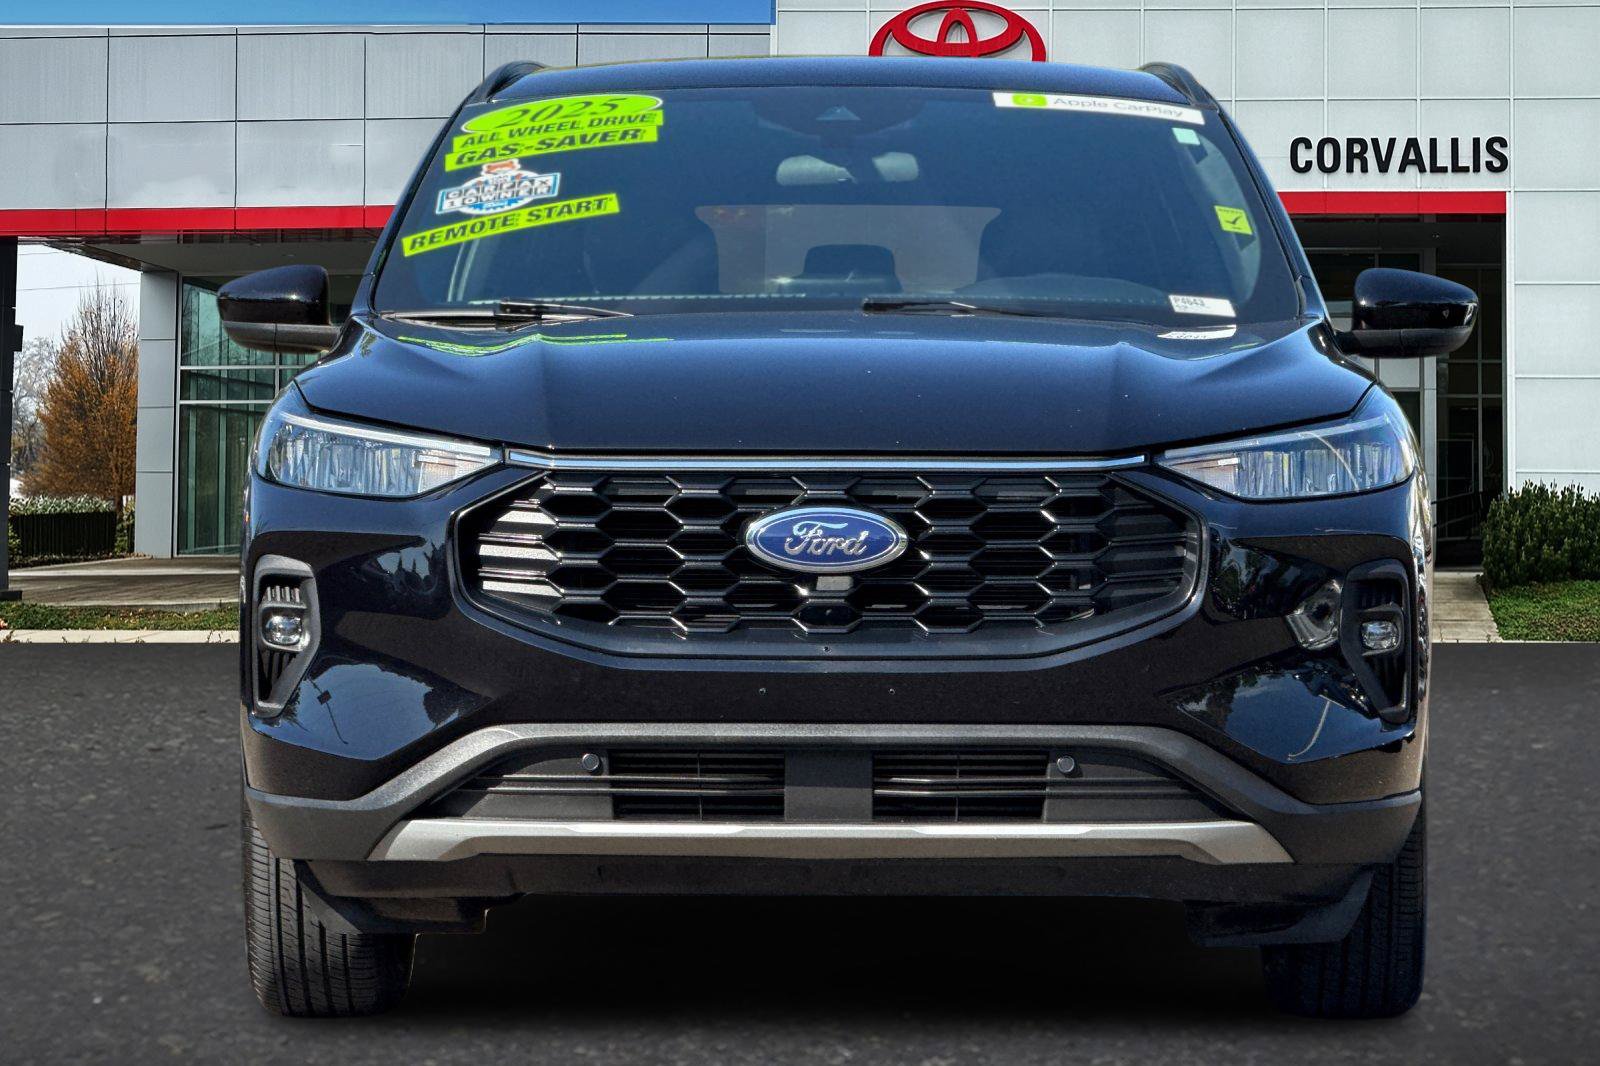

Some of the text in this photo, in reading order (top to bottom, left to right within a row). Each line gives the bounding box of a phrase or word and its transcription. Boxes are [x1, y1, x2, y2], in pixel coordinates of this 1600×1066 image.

[495, 98, 628, 129] 2025
[1053, 98, 1184, 119] Apple CarPlay
[456, 128, 643, 165] GAS-SAVER
[461, 112, 657, 148] ALL WHEEL DRIVE
[1290, 136, 1509, 174] CORVALLIS
[409, 198, 609, 250] REMOTE START
[784, 521, 869, 555] Ford
